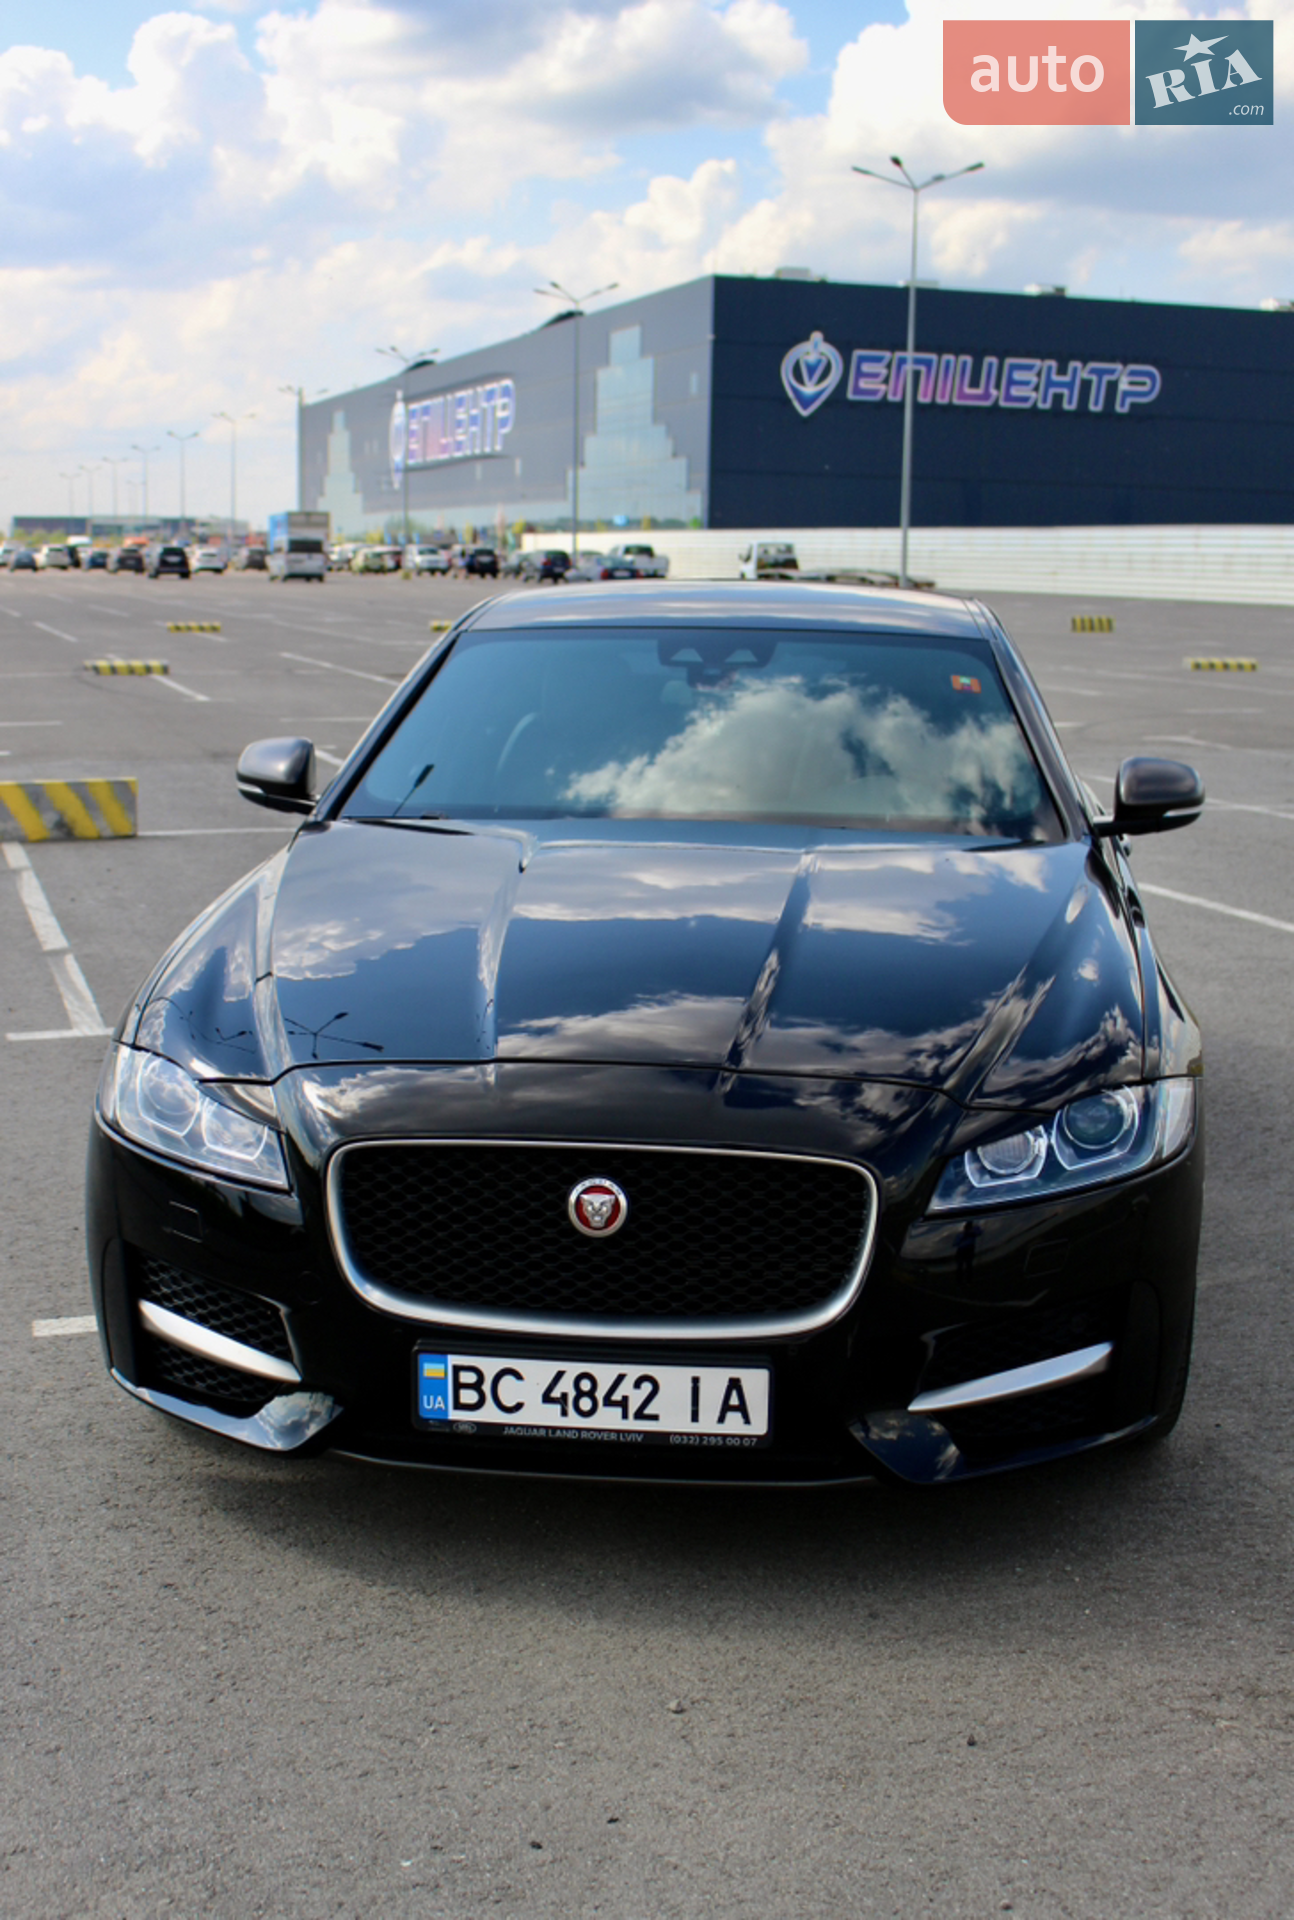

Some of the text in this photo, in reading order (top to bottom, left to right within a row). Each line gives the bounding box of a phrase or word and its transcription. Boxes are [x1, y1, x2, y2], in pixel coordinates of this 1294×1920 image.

[847, 349, 1162, 414] ЕПІЦЕНТР
[452, 1364, 525, 1414] BC
[541, 1369, 660, 1422] 4842
[423, 1394, 446, 1412] UA
[503, 1426, 644, 1443] JAGUAR LAND ROVER LVIV
[669, 1434, 700, 1445] (032)
[702, 1436, 723, 1445] 295
